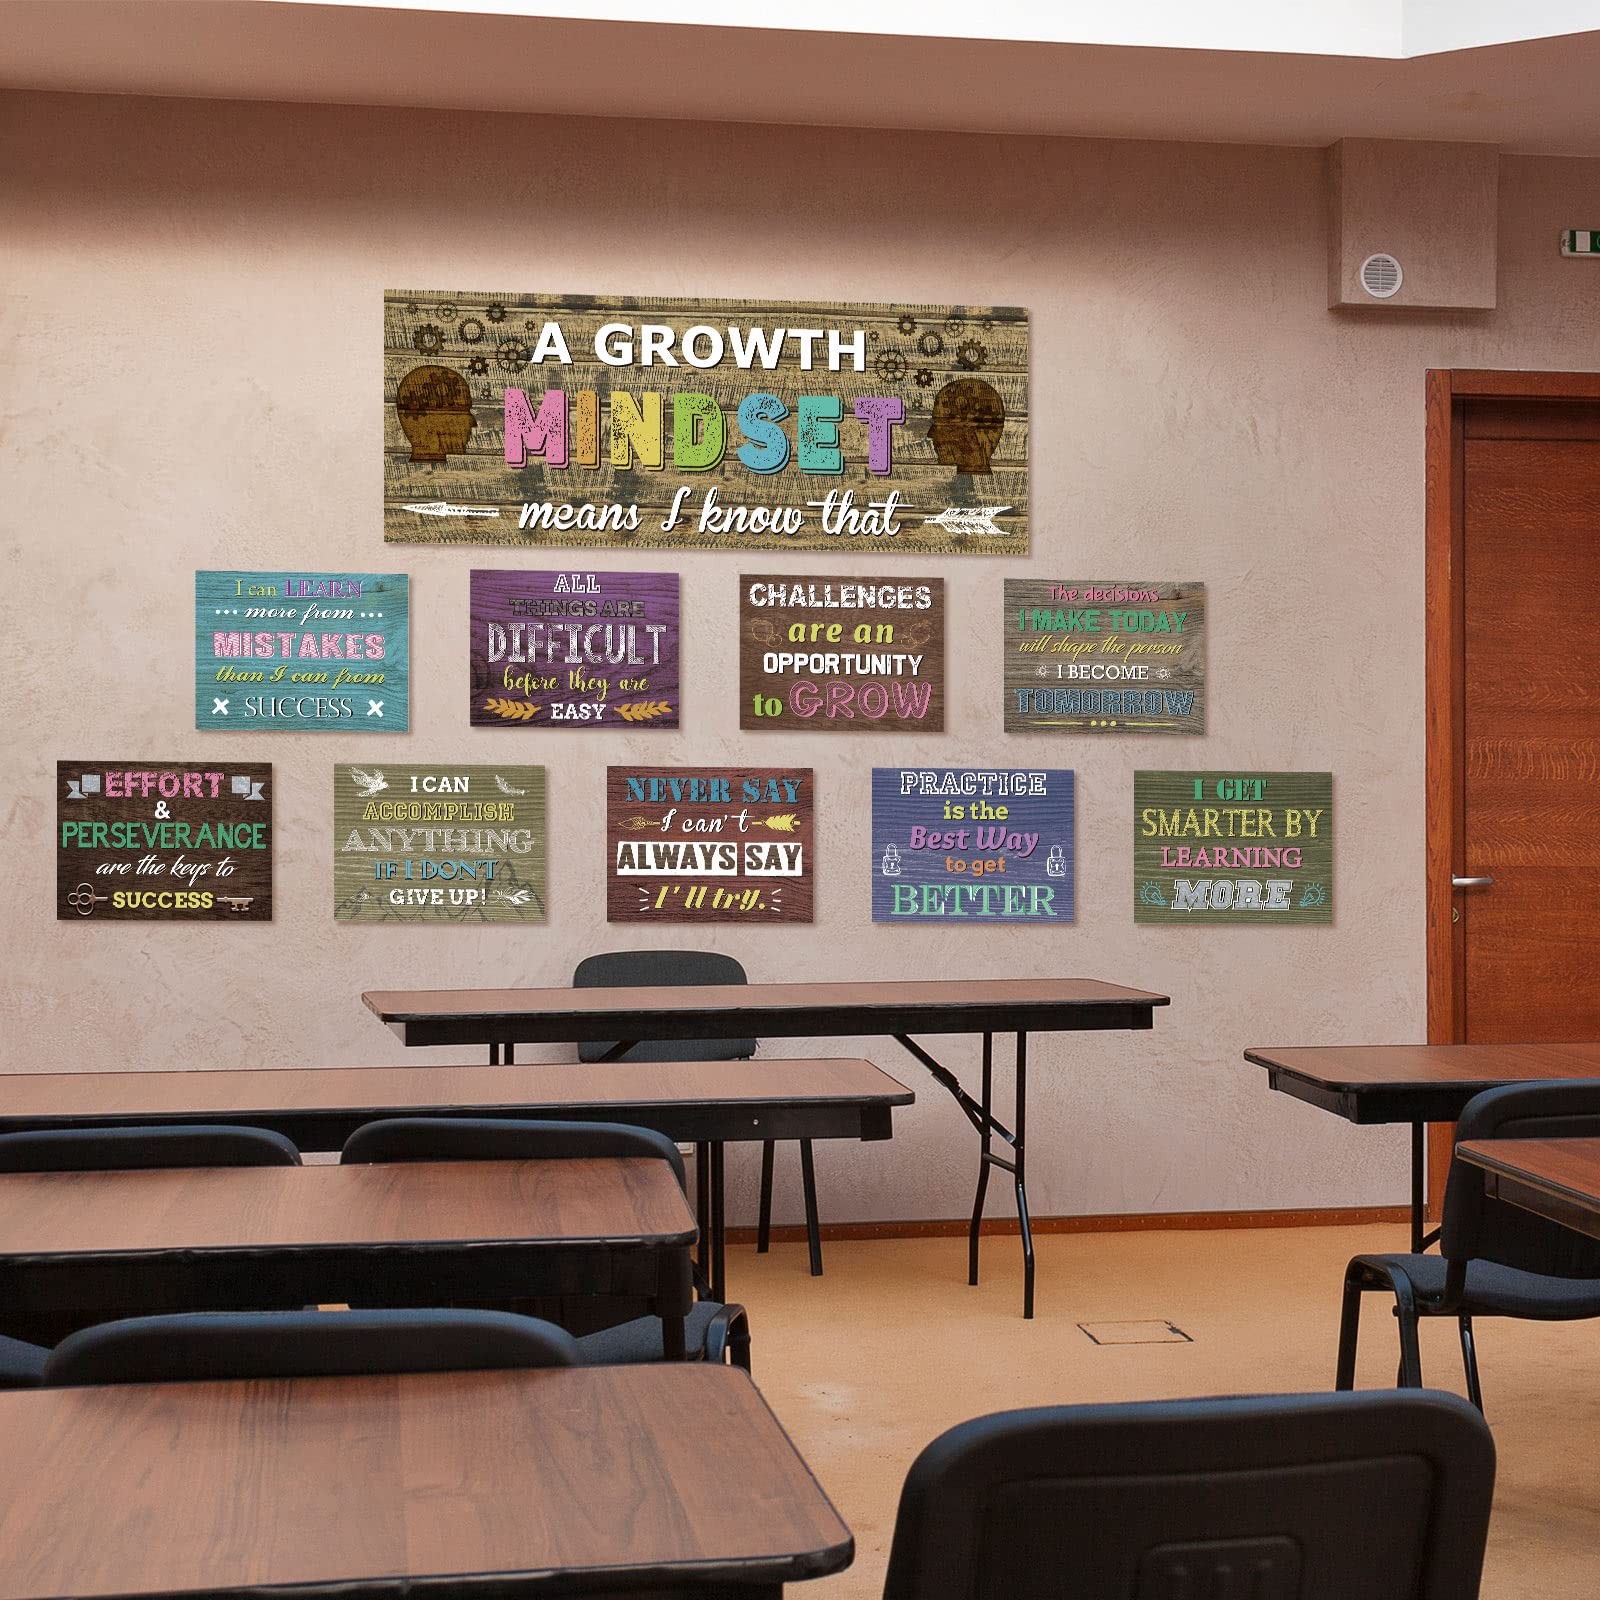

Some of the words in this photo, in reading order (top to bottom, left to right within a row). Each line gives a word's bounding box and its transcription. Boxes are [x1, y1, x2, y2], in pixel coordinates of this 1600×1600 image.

[532, 322, 574, 366] A
[595, 324, 868, 372] GROWTH
[504, 388, 906, 476] MINDSET
[519, 499, 642, 532] means
[661, 487, 691, 533] I
[698, 490, 805, 535] know
[807, 488, 914, 537] that
[235, 580, 242, 596] I
[248, 586, 277, 597] can
[284, 580, 362, 598] LEARN
[554, 574, 601, 593] ALL
[1050, 585, 1078, 601] The
[1084, 585, 1159, 602] decisions
[509, 599, 597, 617] THINGS
[601, 601, 645, 617] ARE
[750, 583, 932, 610] CHALLENGES
[244, 608, 297, 619] more
[300, 603, 354, 625] from
[1019, 609, 1025, 631] I
[1032, 609, 1101, 632] MAKE
[1109, 611, 1188, 633] TODAY
[213, 631, 385, 659] MISTAKES
[487, 623, 667, 665] DIFFICULT
[788, 623, 843, 643] are
[854, 624, 894, 644] an
[1019, 635, 1052, 653] will
[1050, 636, 1098, 662] shape
[1101, 636, 1125, 654] the
[1124, 643, 1183, 663] person
[763, 653, 924, 676] OPPORTUNITY
[1057, 665, 1063, 679] I
[1068, 665, 1149, 680] BECOME
[215, 666, 264, 682] than
[269, 666, 288, 682] I
[291, 673, 327, 683] can
[332, 668, 385, 689] from
[503, 664, 559, 697] before
[569, 665, 610, 701] they
[619, 678, 650, 690] are
[244, 697, 353, 718] SUCCESS
[550, 704, 606, 720] EASY
[753, 693, 783, 717] to
[789, 681, 932, 719] GROW
[1014, 688, 1194, 715] TOMORROW
[105, 771, 224, 798] EFFORT
[411, 776, 418, 792] I
[423, 776, 470, 793] CAN
[626, 777, 731, 803] NEVER
[742, 778, 803, 803] SAY
[901, 772, 1047, 796] PRACTICE
[1194, 779, 1203, 800] I
[1217, 779, 1267, 801] GET
[155, 801, 170, 819] &
[363, 802, 514, 821] ACCOMPLISH
[661, 809, 677, 832] I
[682, 809, 755, 833] can't
[944, 801, 965, 820] is
[970, 801, 1009, 820] the
[1142, 808, 1277, 838] SMARTER
[1285, 809, 1323, 838] BY
[62, 822, 267, 849] PERSEVERANCE
[341, 828, 534, 853] ANYTHING
[910, 826, 970, 850] Best
[976, 826, 1039, 857] Way
[375, 861, 399, 879] IF
[405, 859, 412, 880] I
[421, 860, 499, 880] DON'T
[617, 844, 736, 870] ALWAYS
[746, 845, 801, 871] SAY
[946, 857, 967, 872] to
[972, 857, 1006, 876] get
[1161, 847, 1302, 868] LEARNING
[96, 863, 132, 875] are
[136, 855, 166, 875] the
[170, 855, 212, 887] keys
[215, 857, 238, 877] to
[112, 891, 214, 909] SUCCESS
[390, 889, 444, 905] GIVE
[449, 889, 486, 905] UP!
[655, 886, 708, 909] I'll
[712, 888, 765, 911] try.
[890, 884, 1057, 916] BETTER
[1171, 880, 1293, 912] MORE
